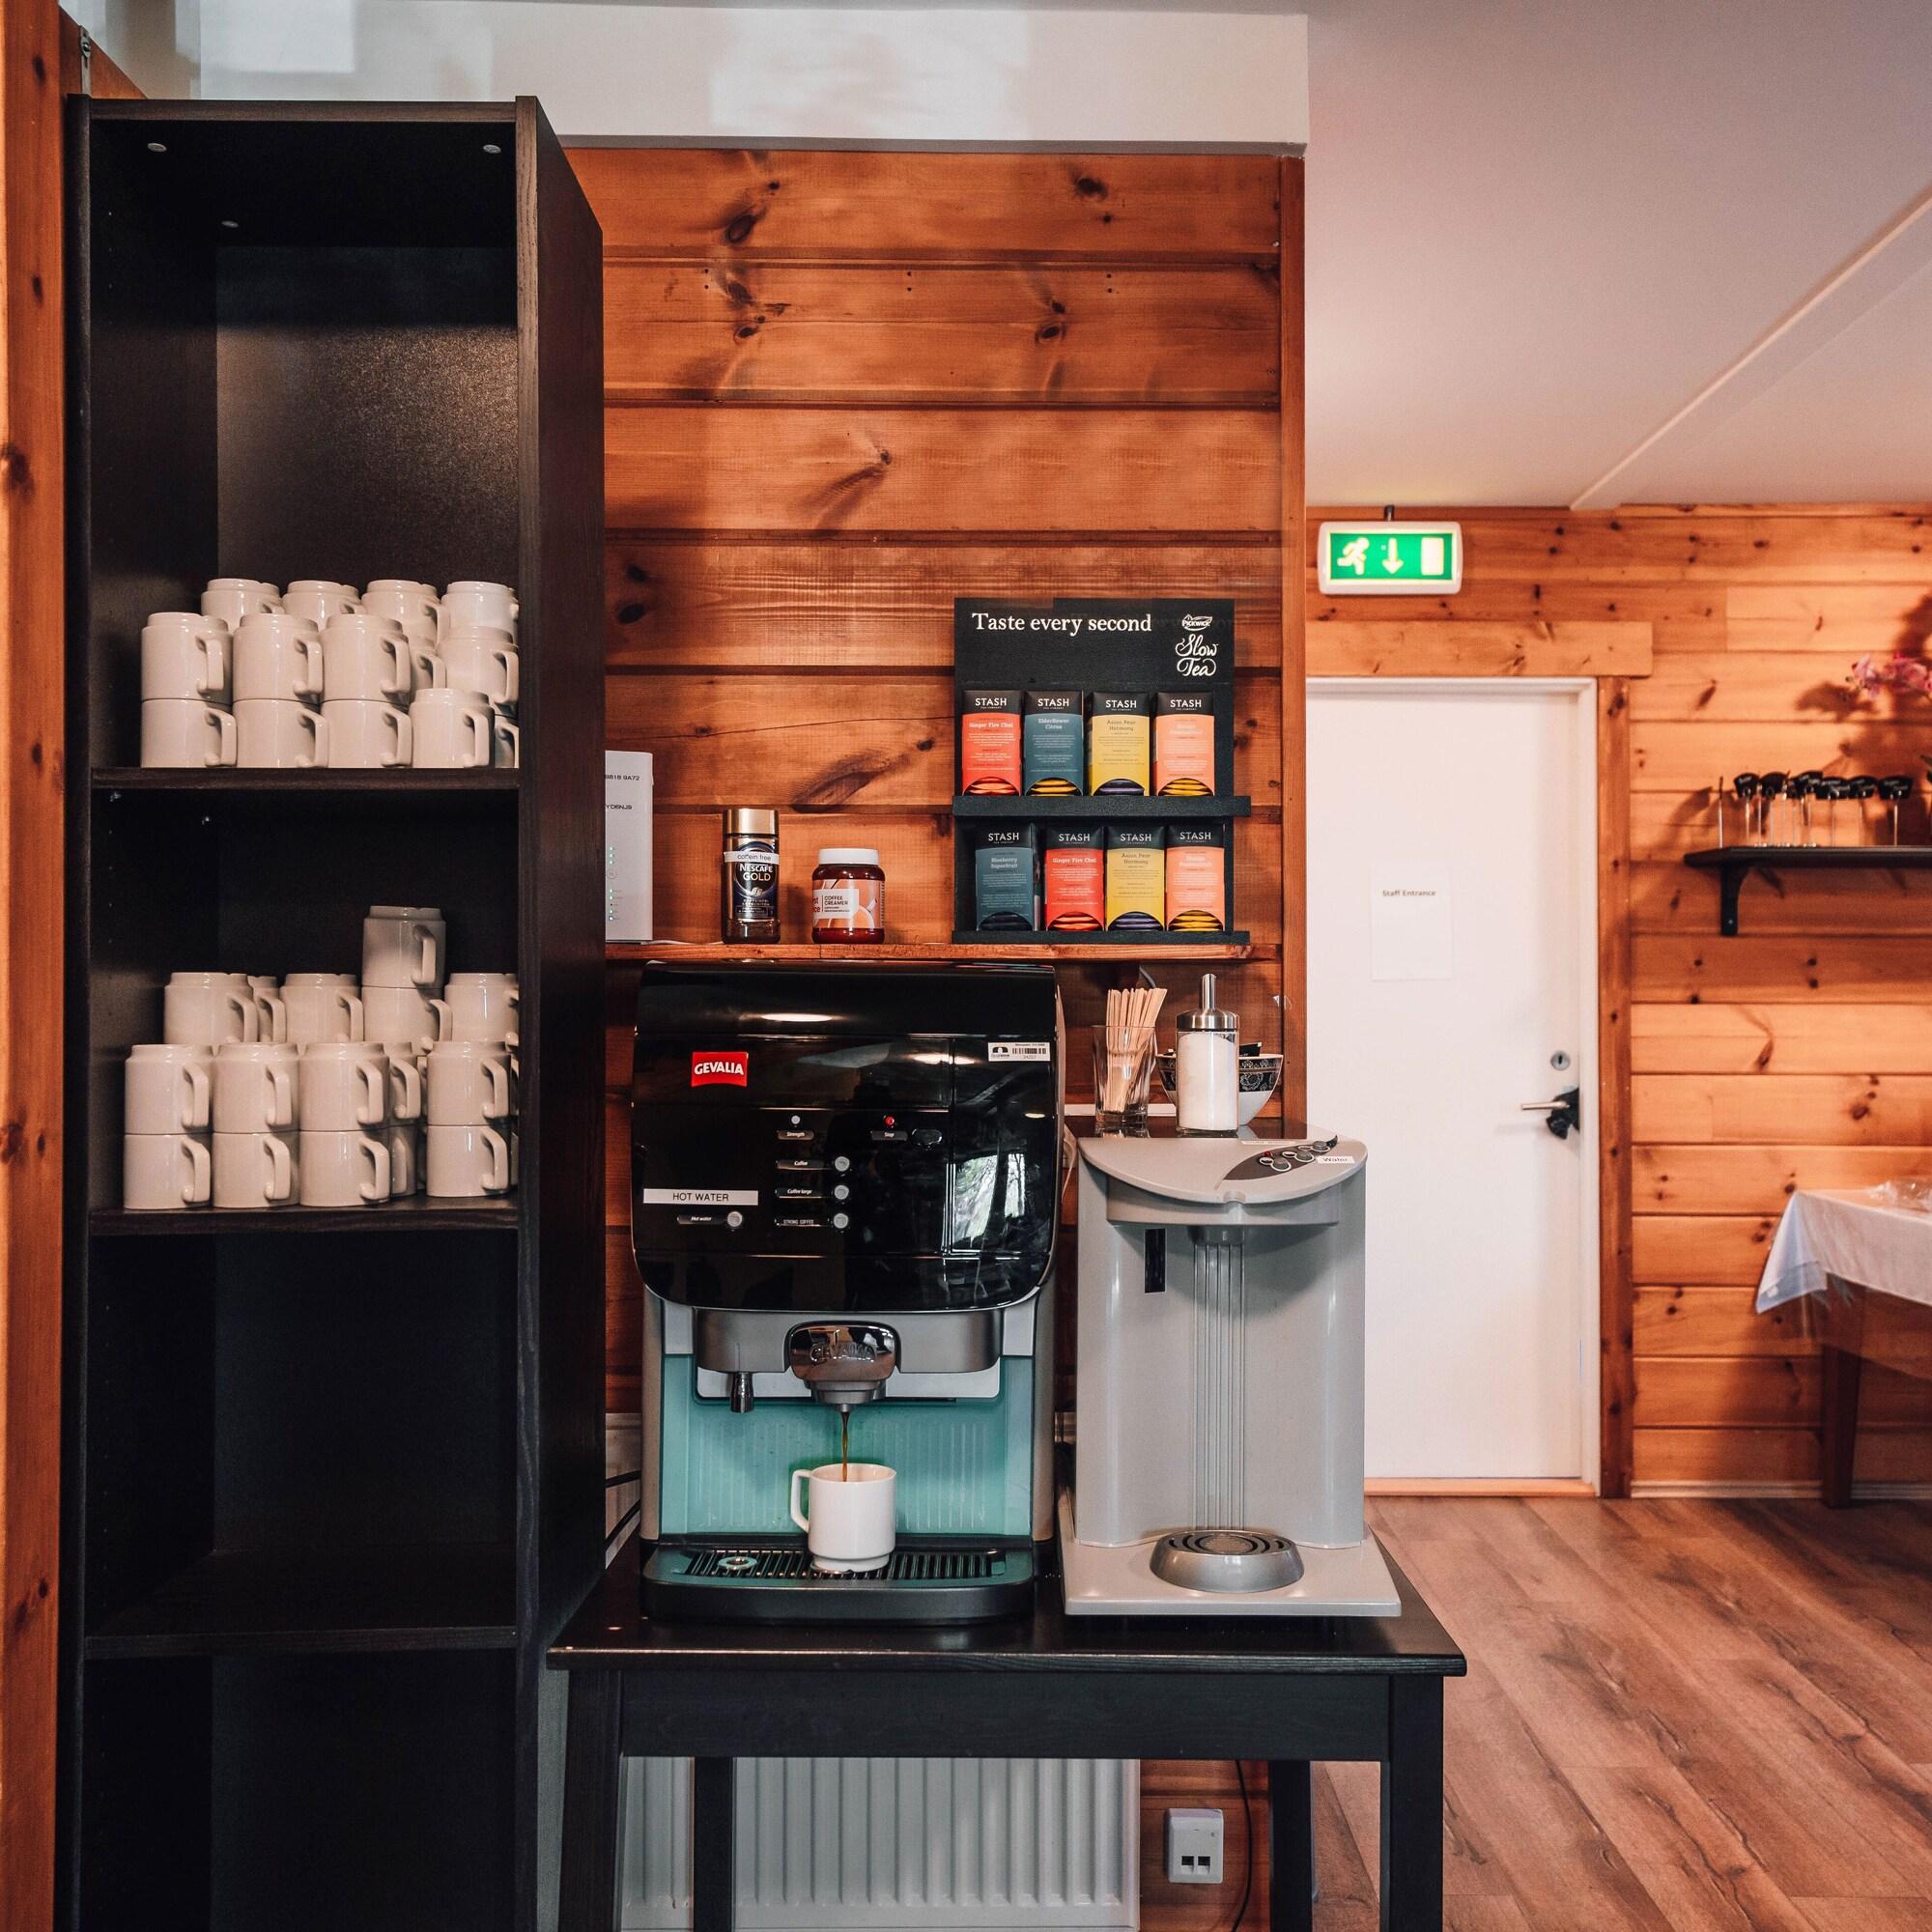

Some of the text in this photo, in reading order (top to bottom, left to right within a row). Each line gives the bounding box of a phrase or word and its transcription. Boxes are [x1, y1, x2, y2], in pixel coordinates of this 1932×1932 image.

[972, 612, 1152, 637] Taste every second
[1175, 633, 1218, 657] Slow
[1177, 657, 1216, 677] Tea
[975, 697, 1008, 707] STASH
[1037, 698, 1070, 707] STASH
[1105, 699, 1137, 709] STASH
[1170, 699, 1202, 708] STASH
[988, 832, 1020, 841] STASH
[1059, 833, 1091, 842] STASH
[1121, 833, 1151, 842] STASH
[1179, 832, 1211, 840] STASH
[743, 872, 771, 881] GOLD
[694, 1062, 744, 1075] GEVALIA
[672, 1192, 729, 1203] HOT WATER
